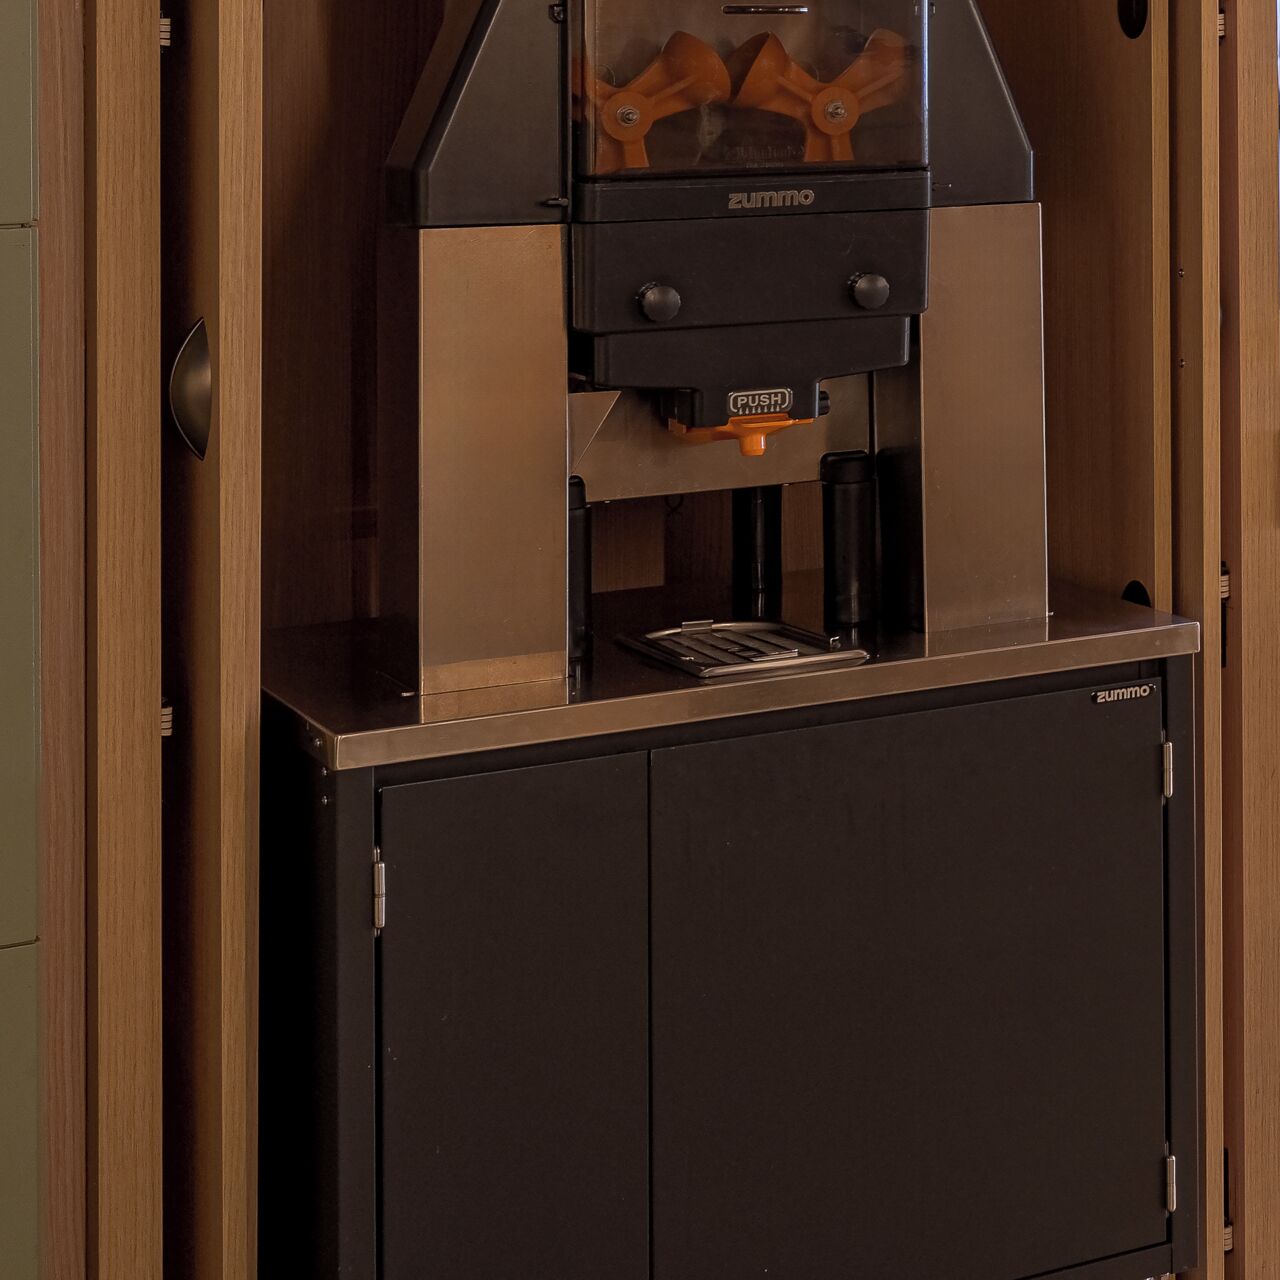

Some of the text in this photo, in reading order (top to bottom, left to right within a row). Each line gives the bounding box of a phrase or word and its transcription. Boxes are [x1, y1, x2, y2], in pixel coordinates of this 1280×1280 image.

[728, 189, 815, 209] zummo
[738, 393, 781, 407] PUSH
[1097, 685, 1150, 703] zummo
